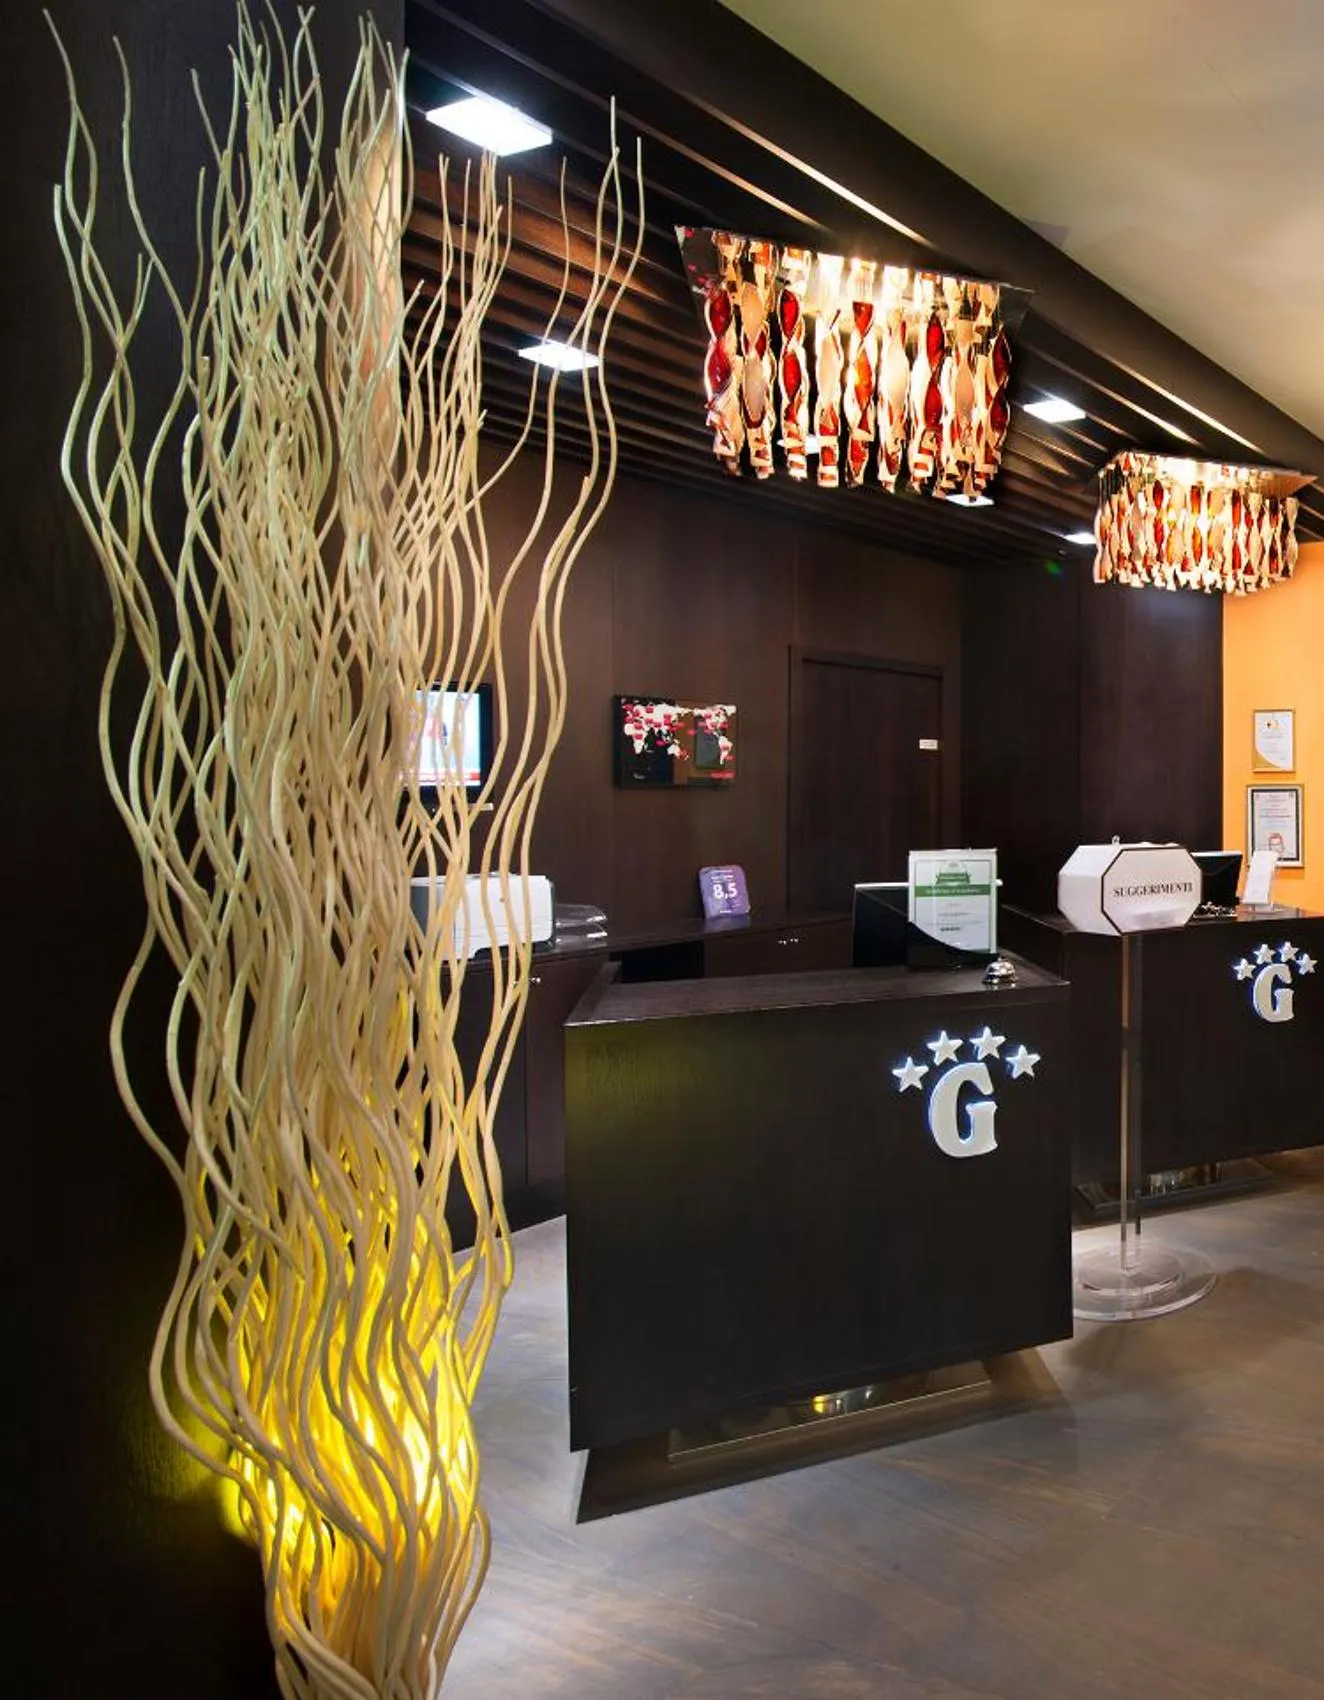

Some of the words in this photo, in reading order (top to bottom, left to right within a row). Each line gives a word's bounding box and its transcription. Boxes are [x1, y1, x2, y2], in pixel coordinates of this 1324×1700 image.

[713, 882, 737, 899] 8,5
[1113, 882, 1193, 897] SUGGERIMENTI
[1253, 963, 1294, 1022] G
[929, 1062, 998, 1157] G
